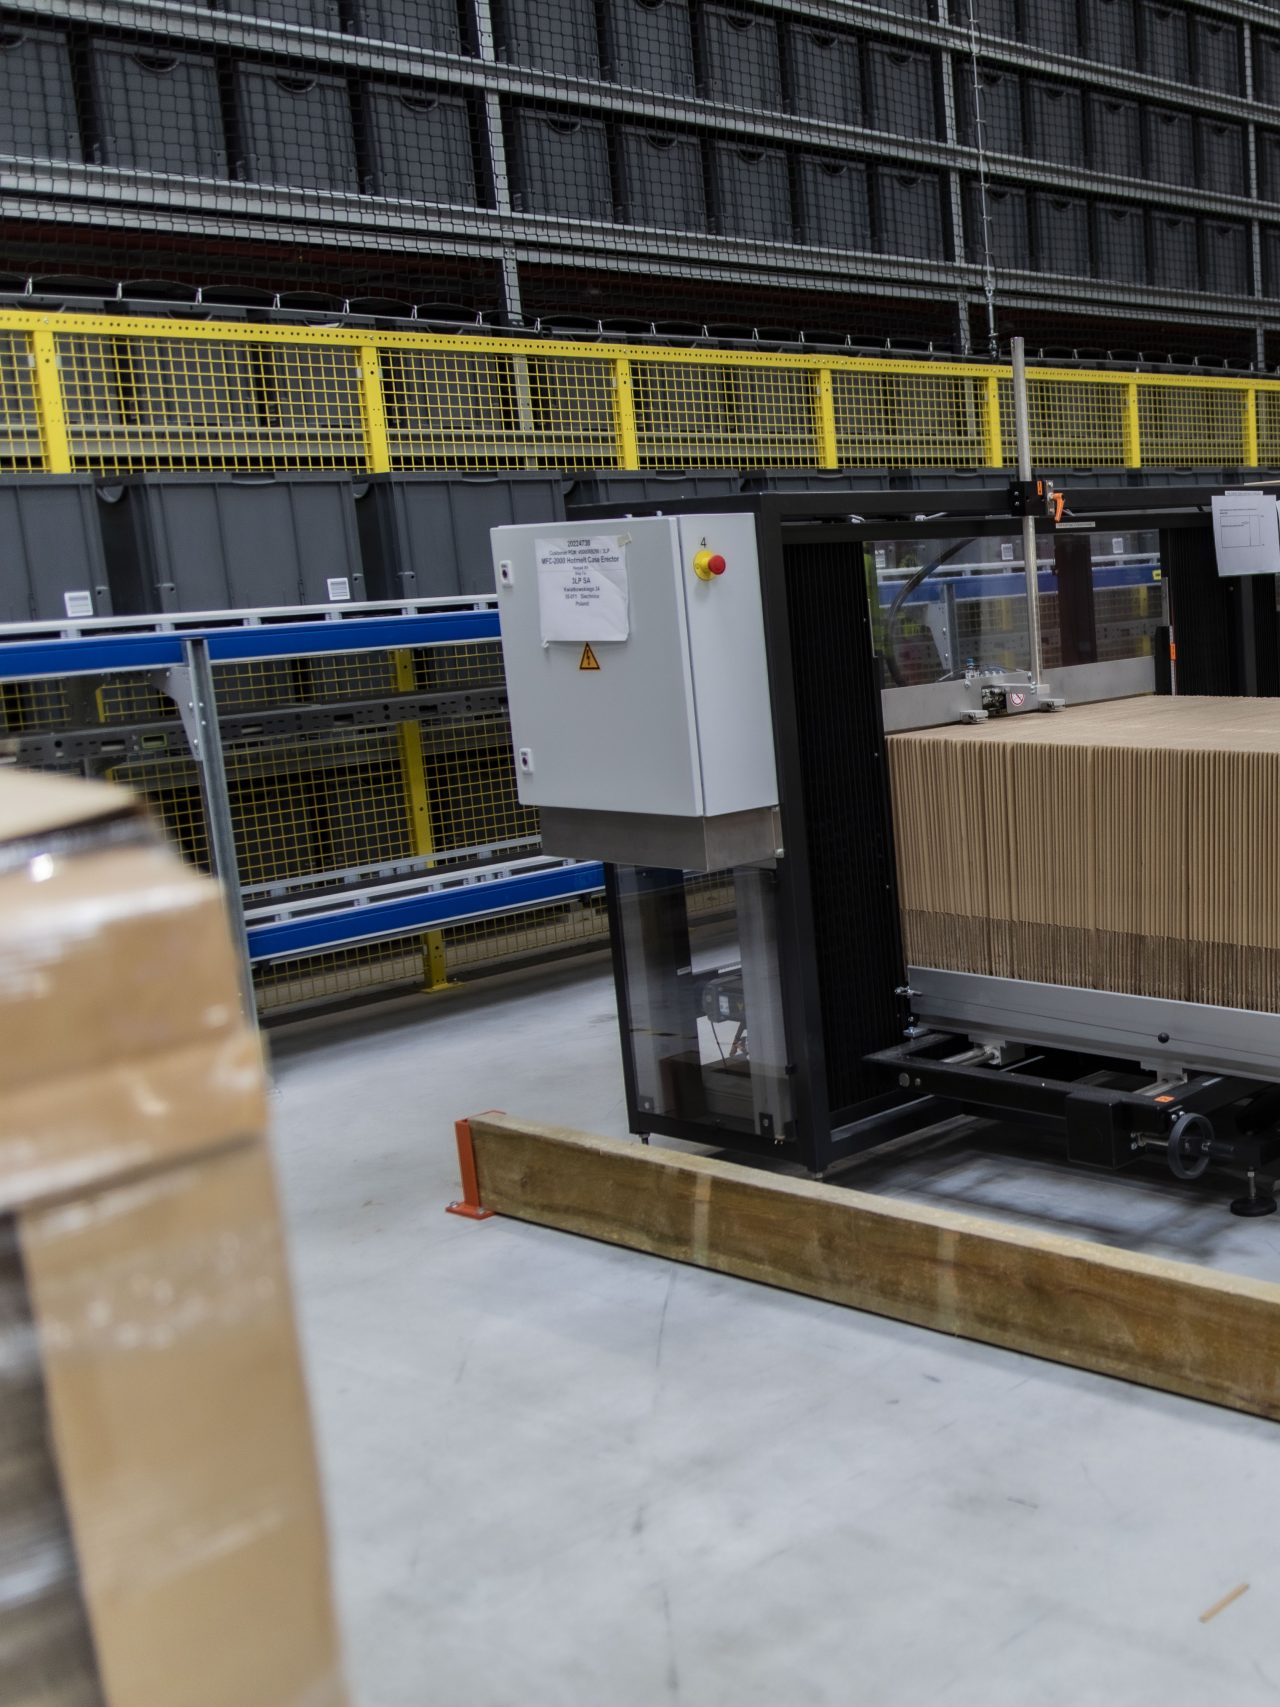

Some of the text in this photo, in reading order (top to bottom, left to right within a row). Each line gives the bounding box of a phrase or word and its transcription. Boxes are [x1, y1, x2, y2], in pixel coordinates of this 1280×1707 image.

[700, 536, 706, 548] 4
[566, 556, 587, 564] Hotmelt
[600, 555, 620, 563] Erector
